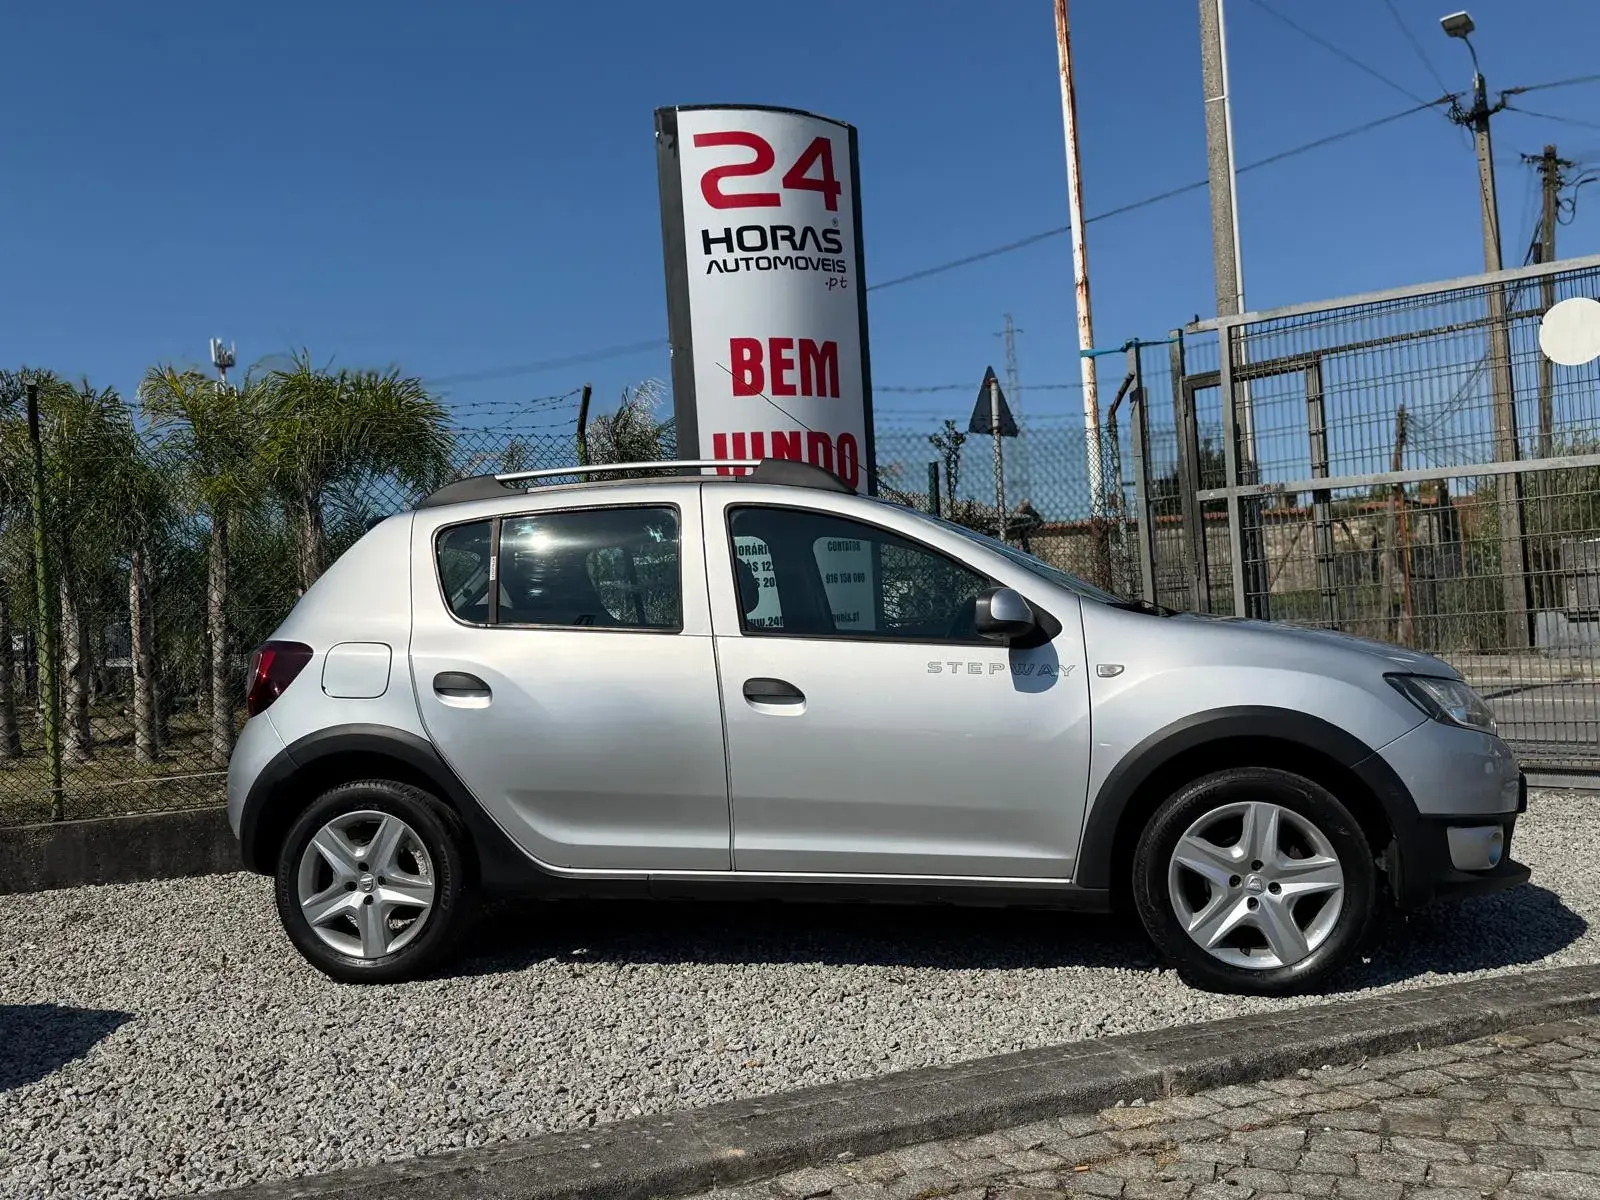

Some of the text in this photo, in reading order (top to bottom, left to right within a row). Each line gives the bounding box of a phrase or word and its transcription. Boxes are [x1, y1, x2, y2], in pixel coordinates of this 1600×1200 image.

[693, 131, 841, 211] 24
[701, 225, 843, 255] HORAS
[706, 256, 847, 275] AUTOMOVEIS
[730, 337, 840, 398] BEM
[736, 542, 770, 556] ORÁRI
[927, 661, 1076, 677] STEPWAY
